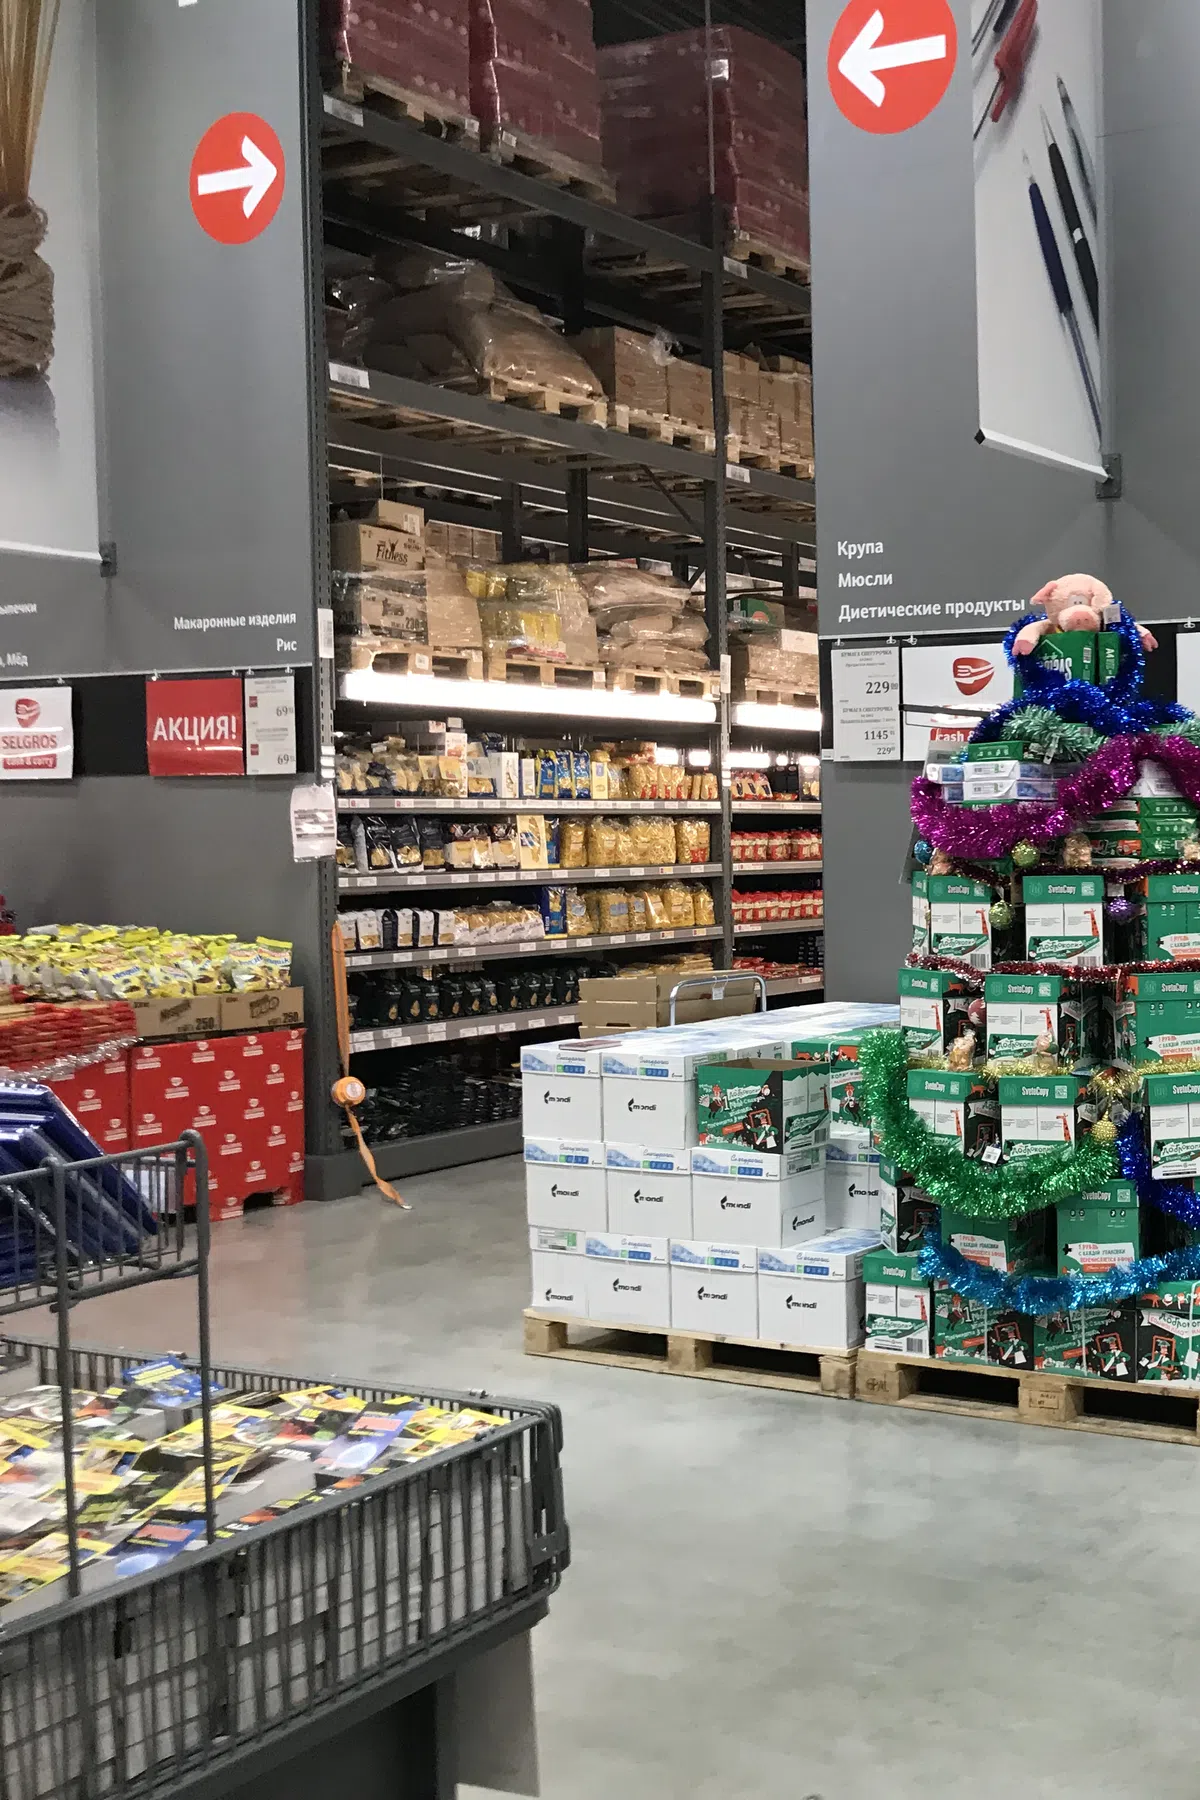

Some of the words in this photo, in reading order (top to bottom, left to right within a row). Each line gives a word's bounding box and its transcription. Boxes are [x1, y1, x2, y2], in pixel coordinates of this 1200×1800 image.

[837, 541, 884, 559] Крупа
[838, 573, 893, 587] Мюсли
[839, 603, 941, 622] Диетические
[945, 599, 1025, 618] продукты
[173, 616, 246, 631] Макаронные
[248, 612, 297, 628] изделия
[276, 638, 297, 651] Рис
[865, 681, 890, 694] 229
[276, 705, 289, 716] 69
[153, 714, 237, 744] АКЦИЯ!
[864, 730, 889, 740] 1145
[938, 730, 964, 742] cash
[2, 734, 58, 749] SELGROS
[877, 747, 892, 755] 229
[277, 754, 290, 765] 69
[947, 885, 970, 895] SvetoCopy
[1048, 885, 1076, 895] SvetoCopy
[1007, 984, 1034, 995] SvetoCopy
[1161, 983, 1188, 993] SvetoCopy
[196, 1017, 215, 1030] 250
[925, 1081, 946, 1092] SvetoCopy
[1021, 1086, 1049, 1097] SvetoCopy
[1172, 1085, 1200, 1095] SvetoCopy
[1082, 1191, 1111, 1201] SvetoCopy
[883, 1266, 906, 1278] SvetoCopy
